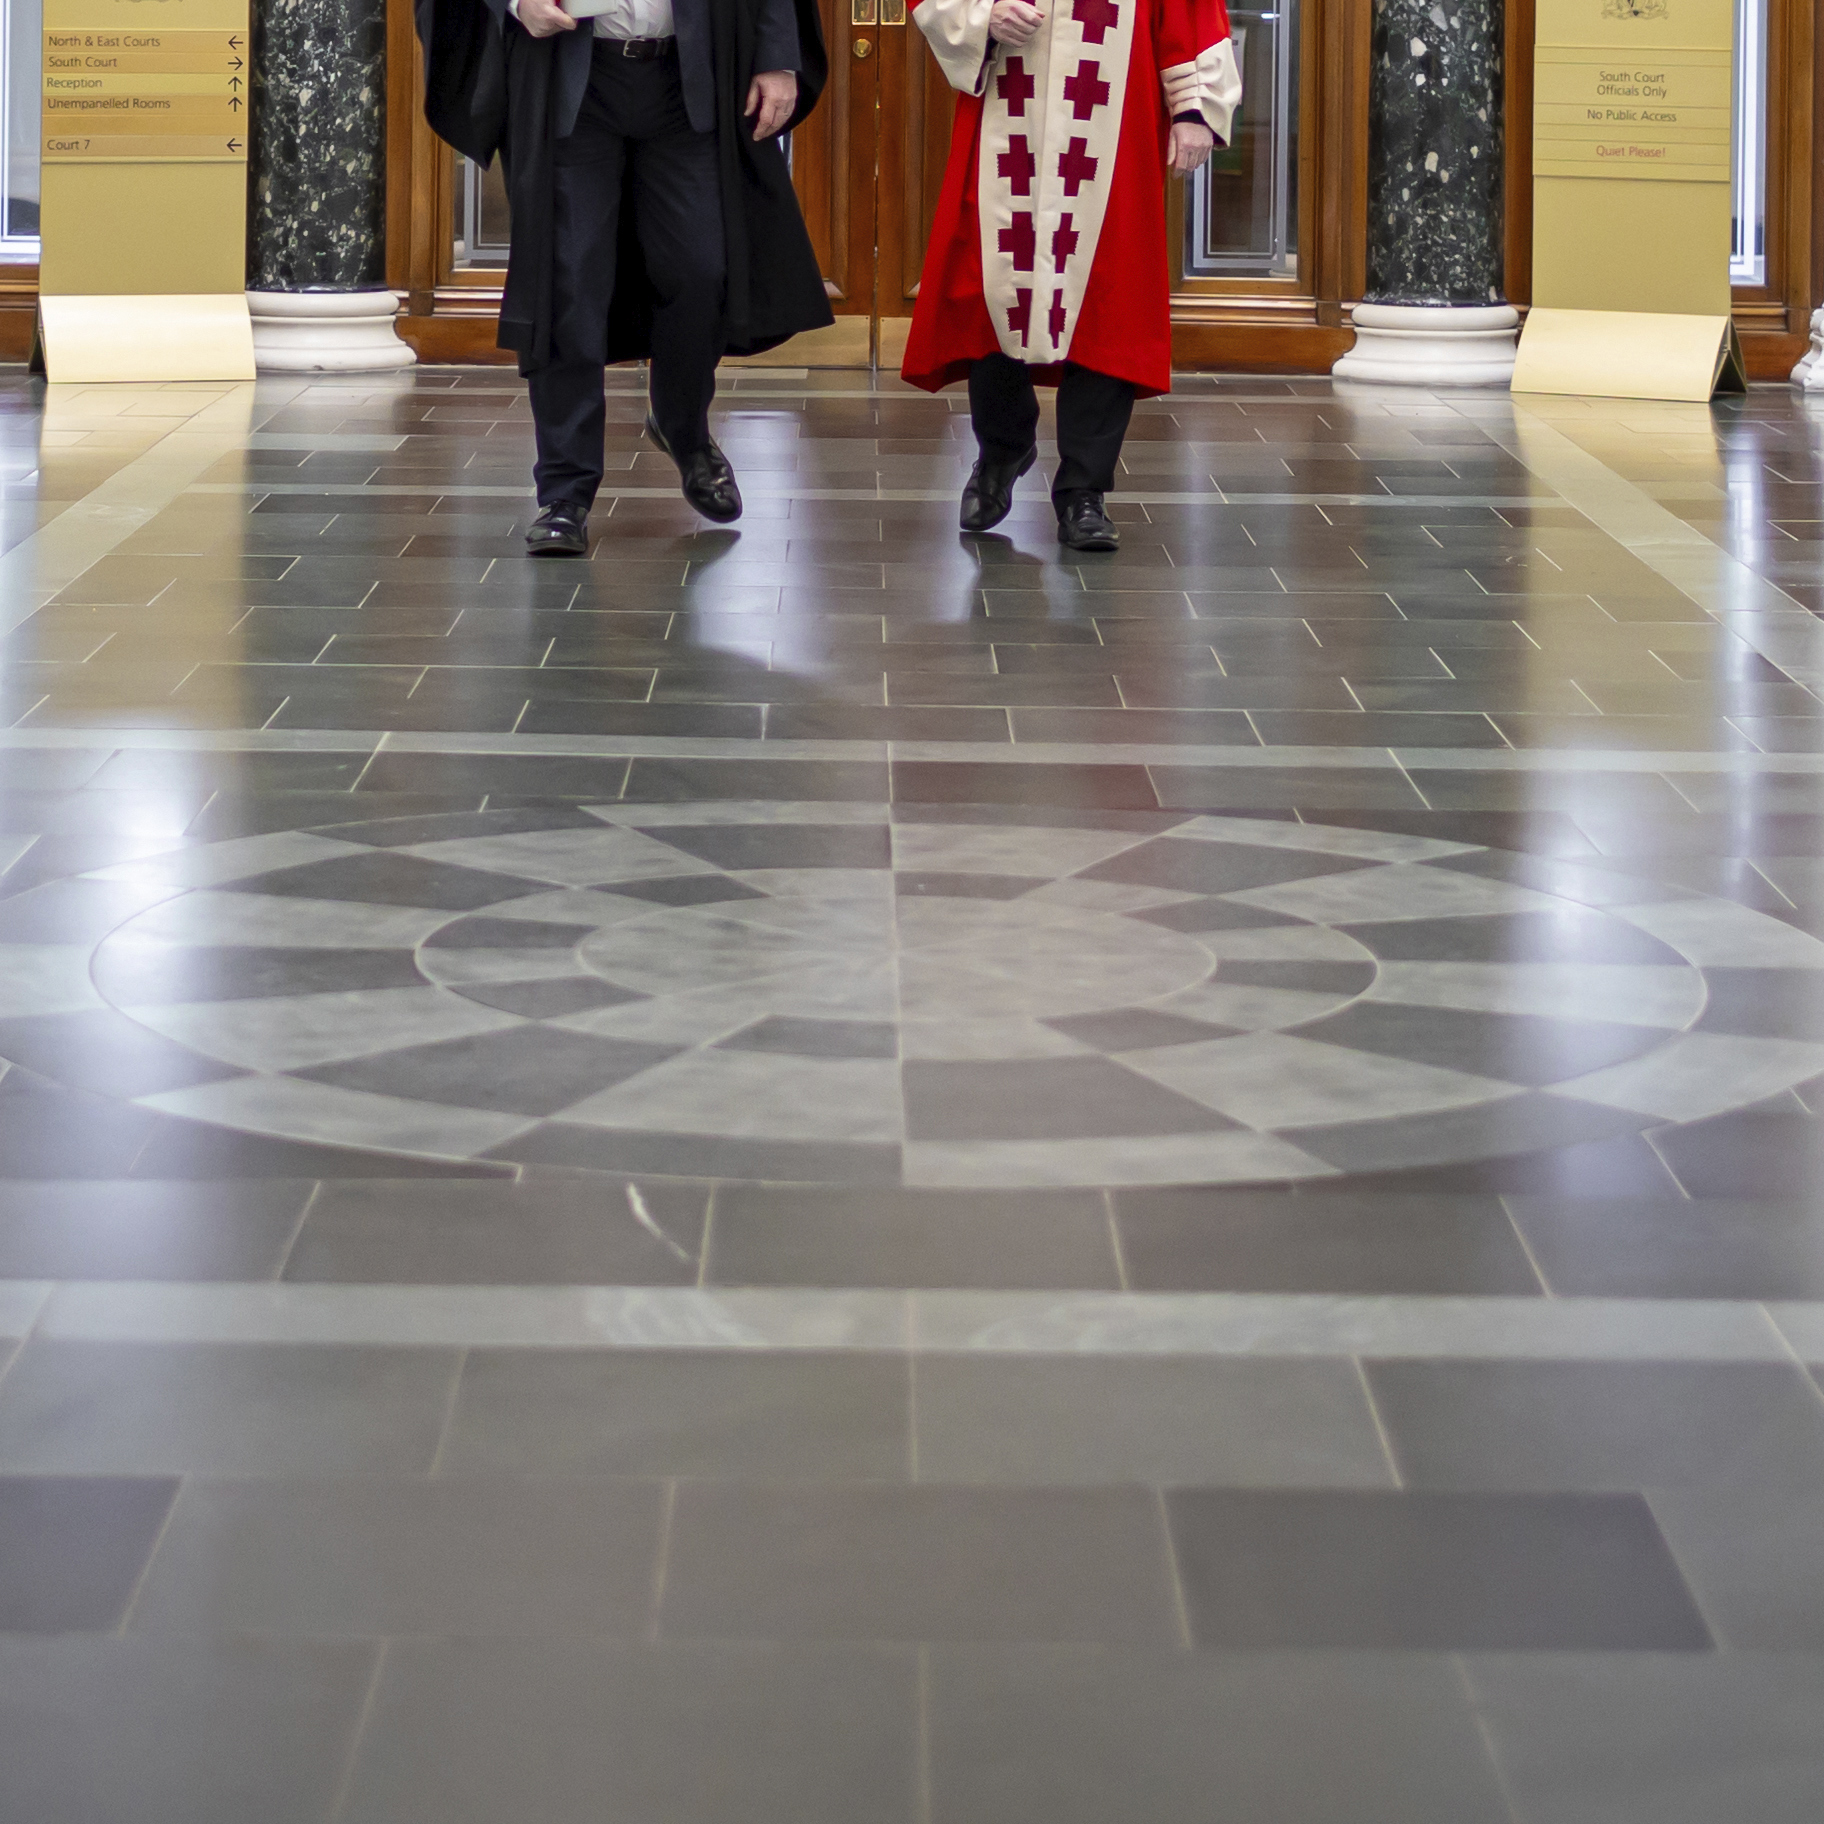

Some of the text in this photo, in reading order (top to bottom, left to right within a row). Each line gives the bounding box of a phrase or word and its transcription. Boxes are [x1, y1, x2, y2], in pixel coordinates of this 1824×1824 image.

[48, 36, 161, 48] North & East Courts
[48, 56, 117, 68] South Court
[1599, 71, 1665, 83] South Court
[46, 77, 103, 91] Reception
[1596, 85, 1667, 99] Officials Only
[47, 97, 171, 112] Unempanelled Rooms
[1587, 109, 1677, 122] No Public Access
[47, 139, 91, 151] Court 7
[1596, 146, 1666, 158] Quiet Please!
